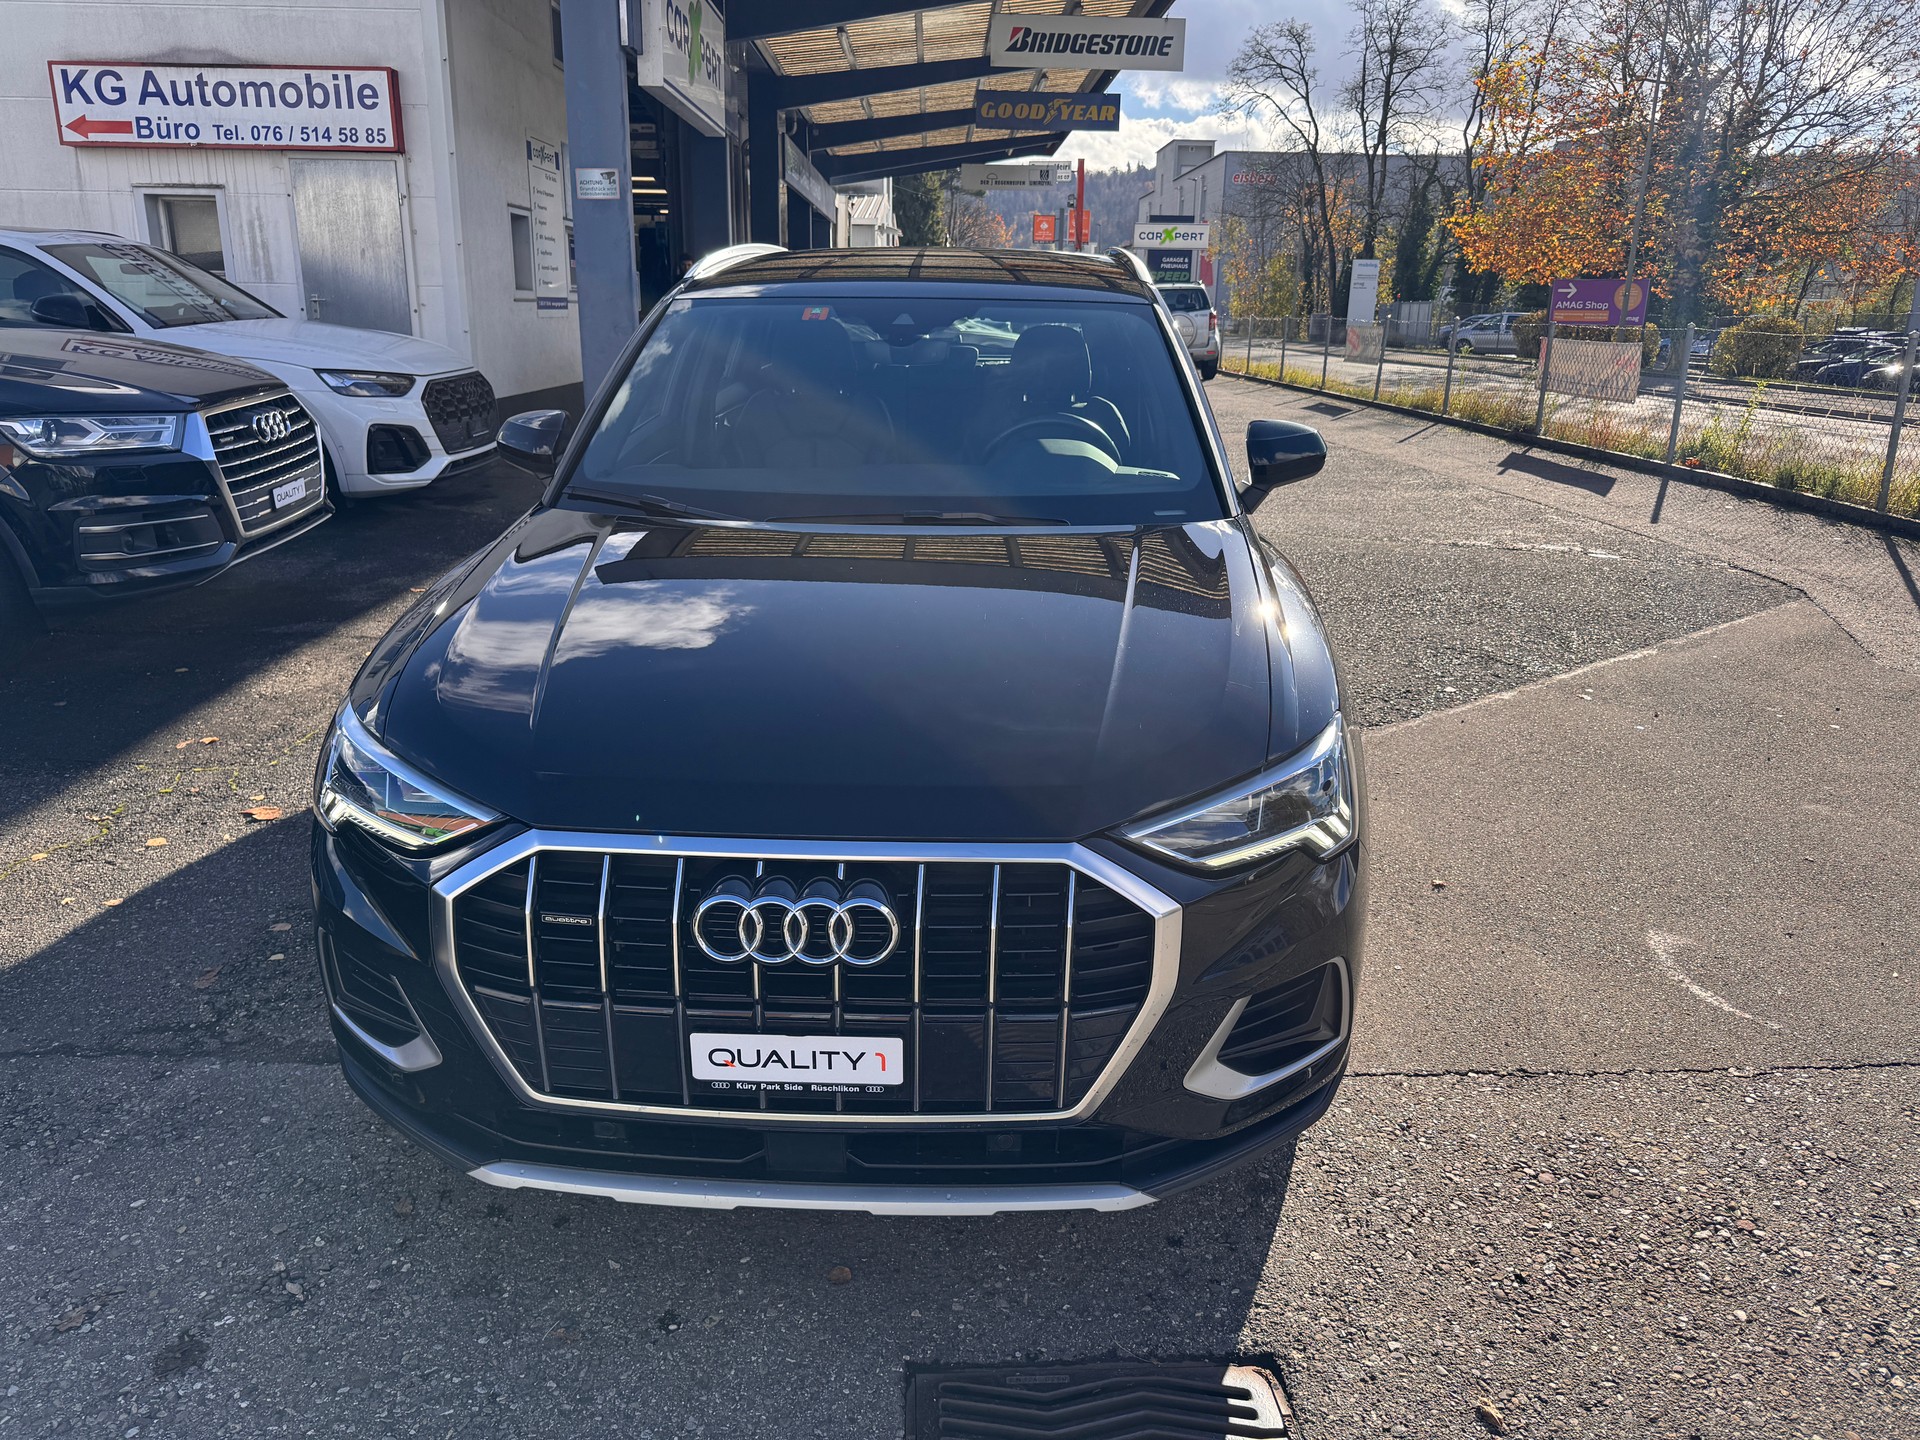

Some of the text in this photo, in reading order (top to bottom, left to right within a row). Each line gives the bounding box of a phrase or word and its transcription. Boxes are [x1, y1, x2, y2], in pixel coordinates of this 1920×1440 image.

[1005, 27, 1174, 56] BRIDGESTONE
[60, 68, 380, 110] KG Automobile
[135, 116, 387, 144] Büro Tel. 076 / 514 58 85
[1555, 301, 1609, 310] AMAG Shop
[275, 486, 301, 503] QUALITY
[545, 916, 588, 924] quattro
[708, 1047, 887, 1072] QUALITY 1
[736, 1082, 860, 1093] Küry Park Side Rüschlikon
